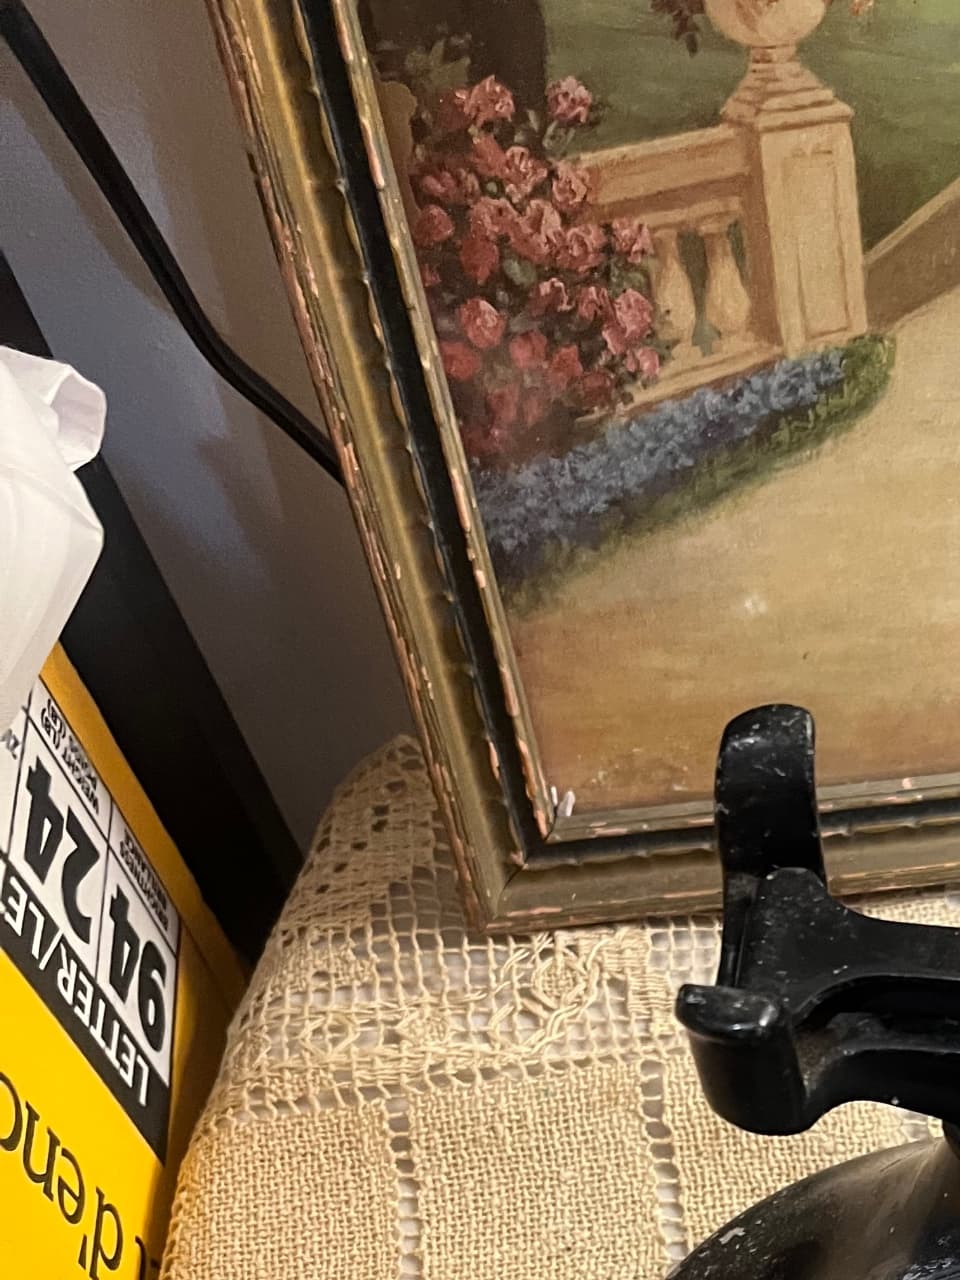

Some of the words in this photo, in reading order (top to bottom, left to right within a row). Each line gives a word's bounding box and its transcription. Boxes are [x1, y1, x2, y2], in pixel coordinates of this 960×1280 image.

[25, 754, 101, 946] 24
[61, 746, 99, 815] WEIGHT
[109, 883, 167, 1053] 94
